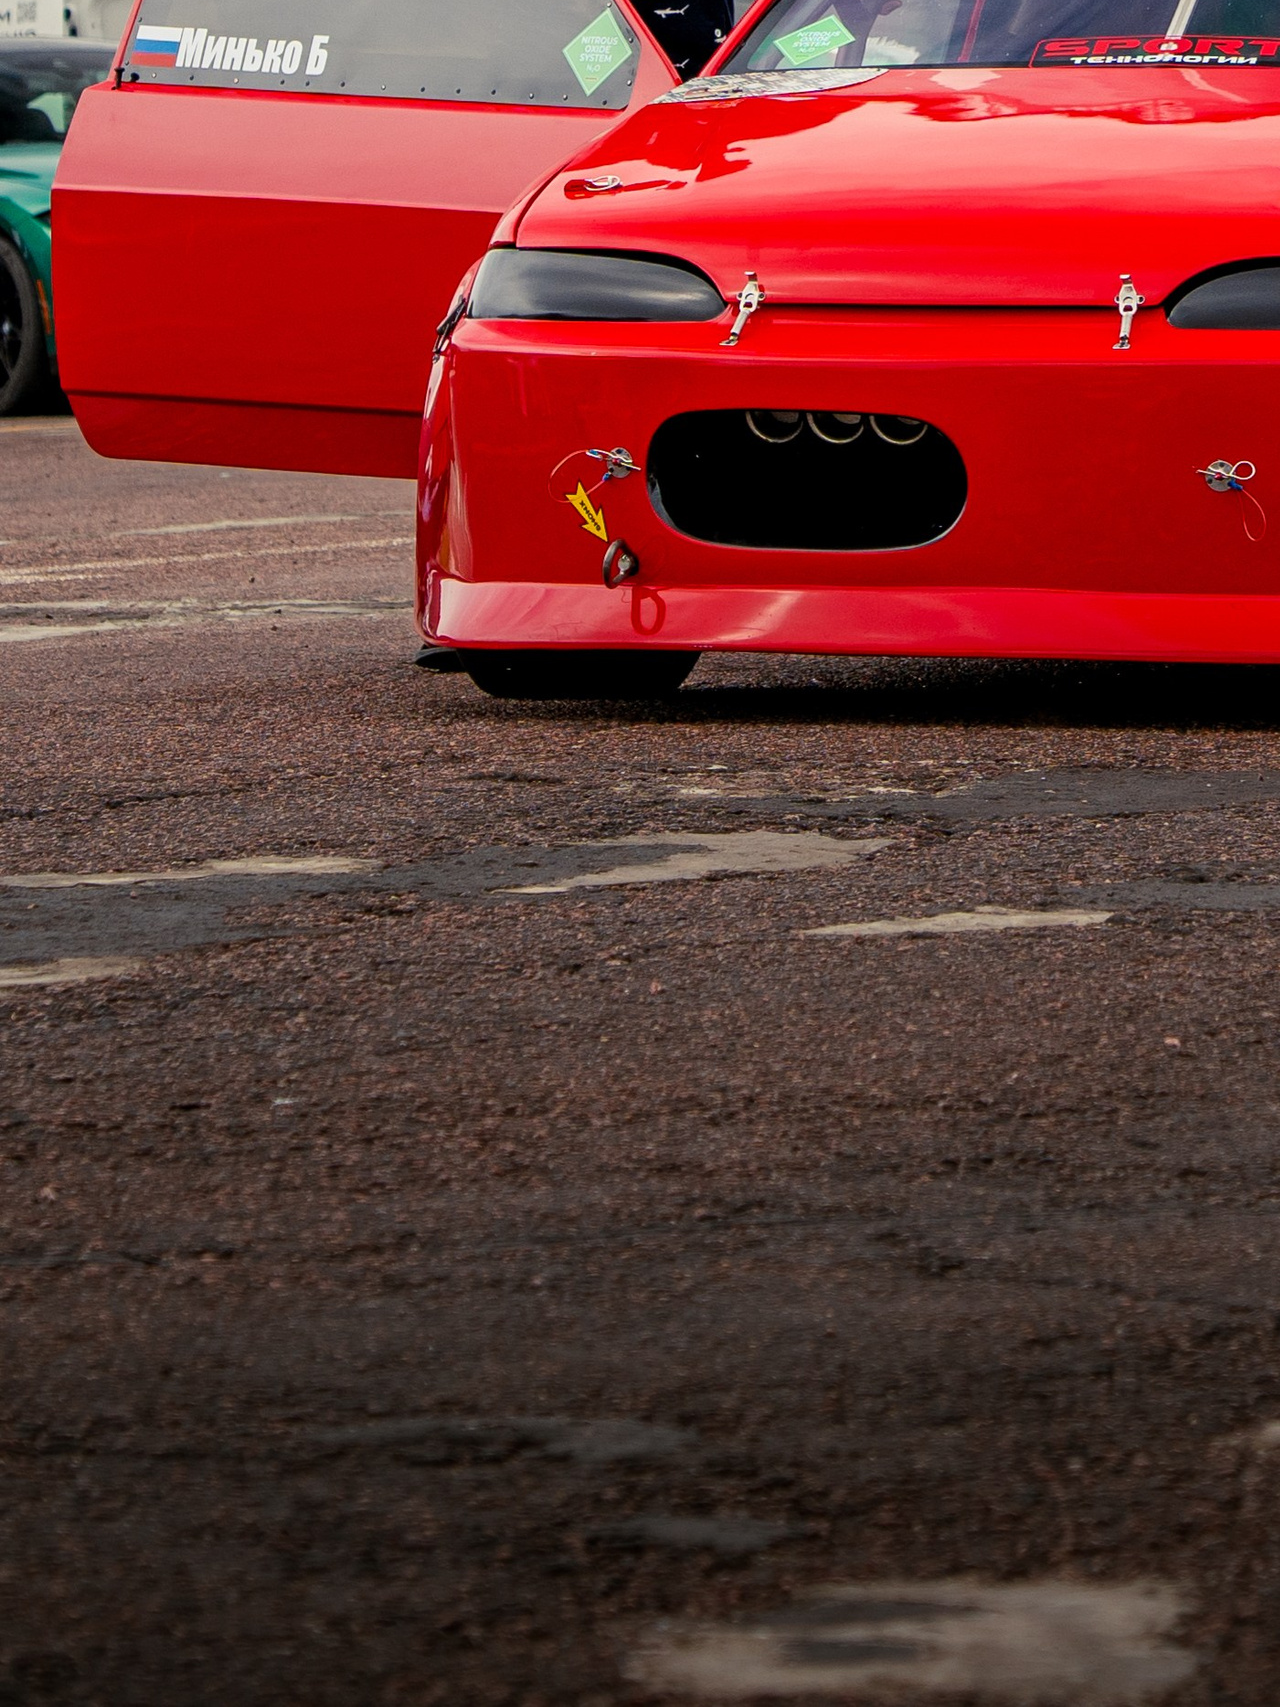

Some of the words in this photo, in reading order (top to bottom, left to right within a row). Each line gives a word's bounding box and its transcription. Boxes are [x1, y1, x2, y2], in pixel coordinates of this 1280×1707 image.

[581, 36, 618, 45] NITROUS
[175, 27, 303, 75] Минько
[305, 35, 330, 75] Б
[584, 44, 612, 54] OXIDE
[579, 53, 612, 63] SYSTEM
